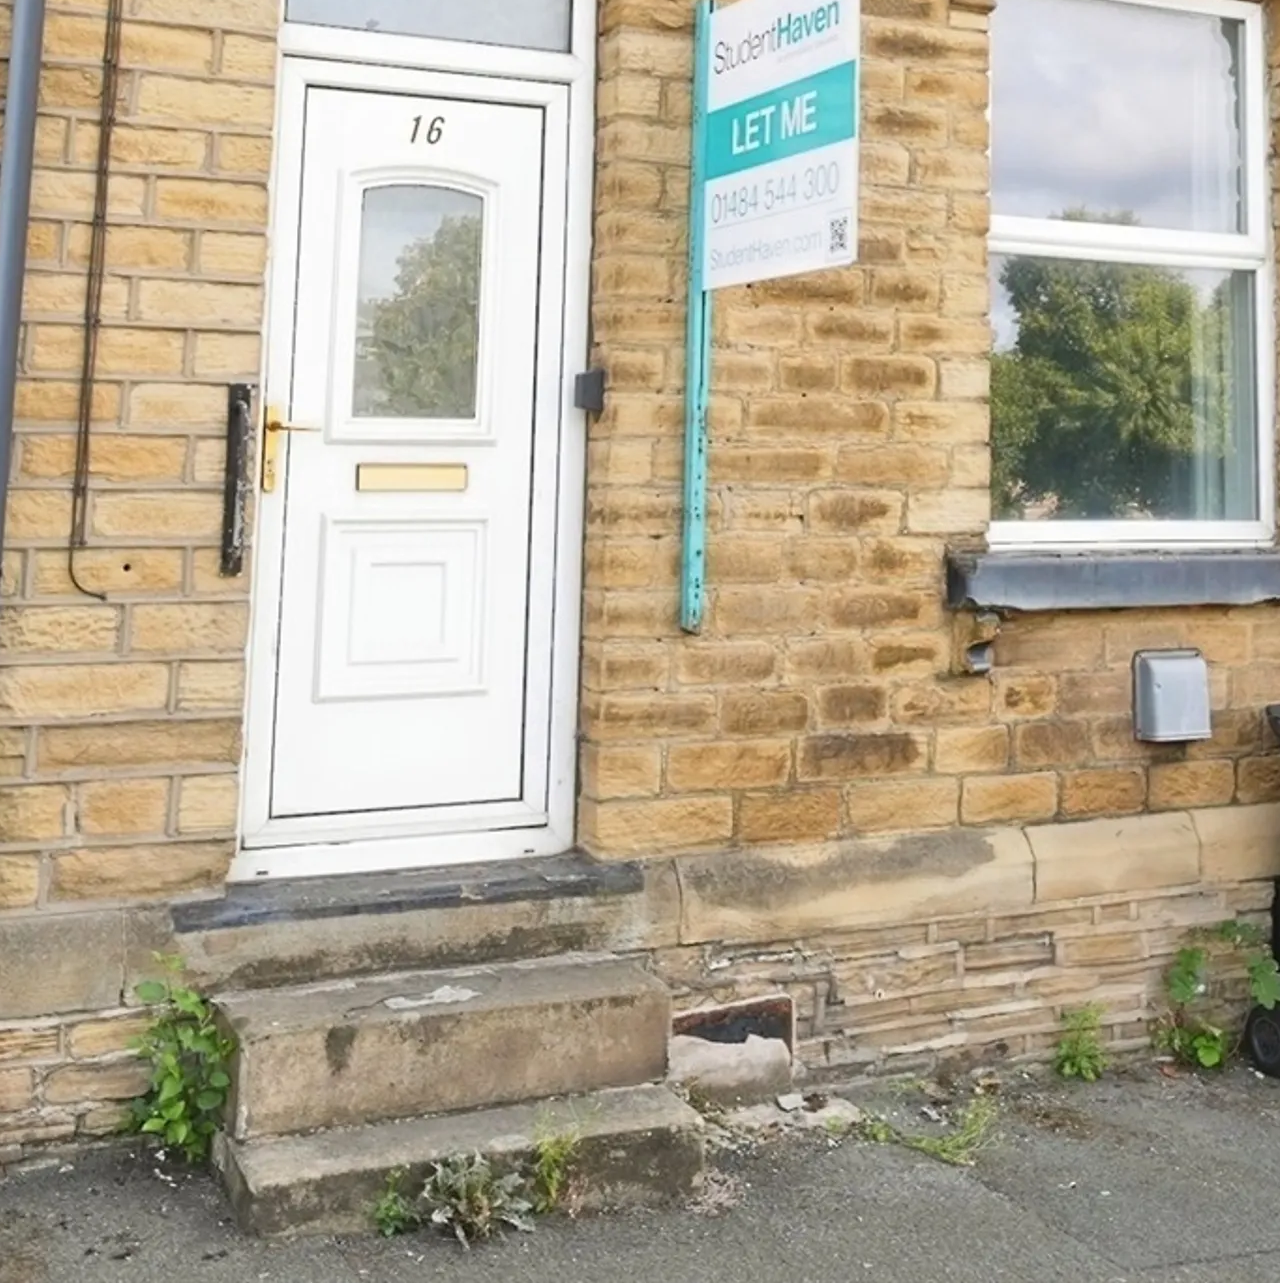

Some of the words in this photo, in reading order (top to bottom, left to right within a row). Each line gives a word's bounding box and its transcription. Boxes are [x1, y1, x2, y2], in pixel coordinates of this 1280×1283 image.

[713, 0, 840, 75] StudentHaven
[410, 114, 446, 145] 16
[731, 104, 777, 156] LET
[780, 89, 818, 140] ME
[711, 183, 758, 224] 01484
[763, 173, 797, 211] 544
[803, 160, 840, 201] 300
